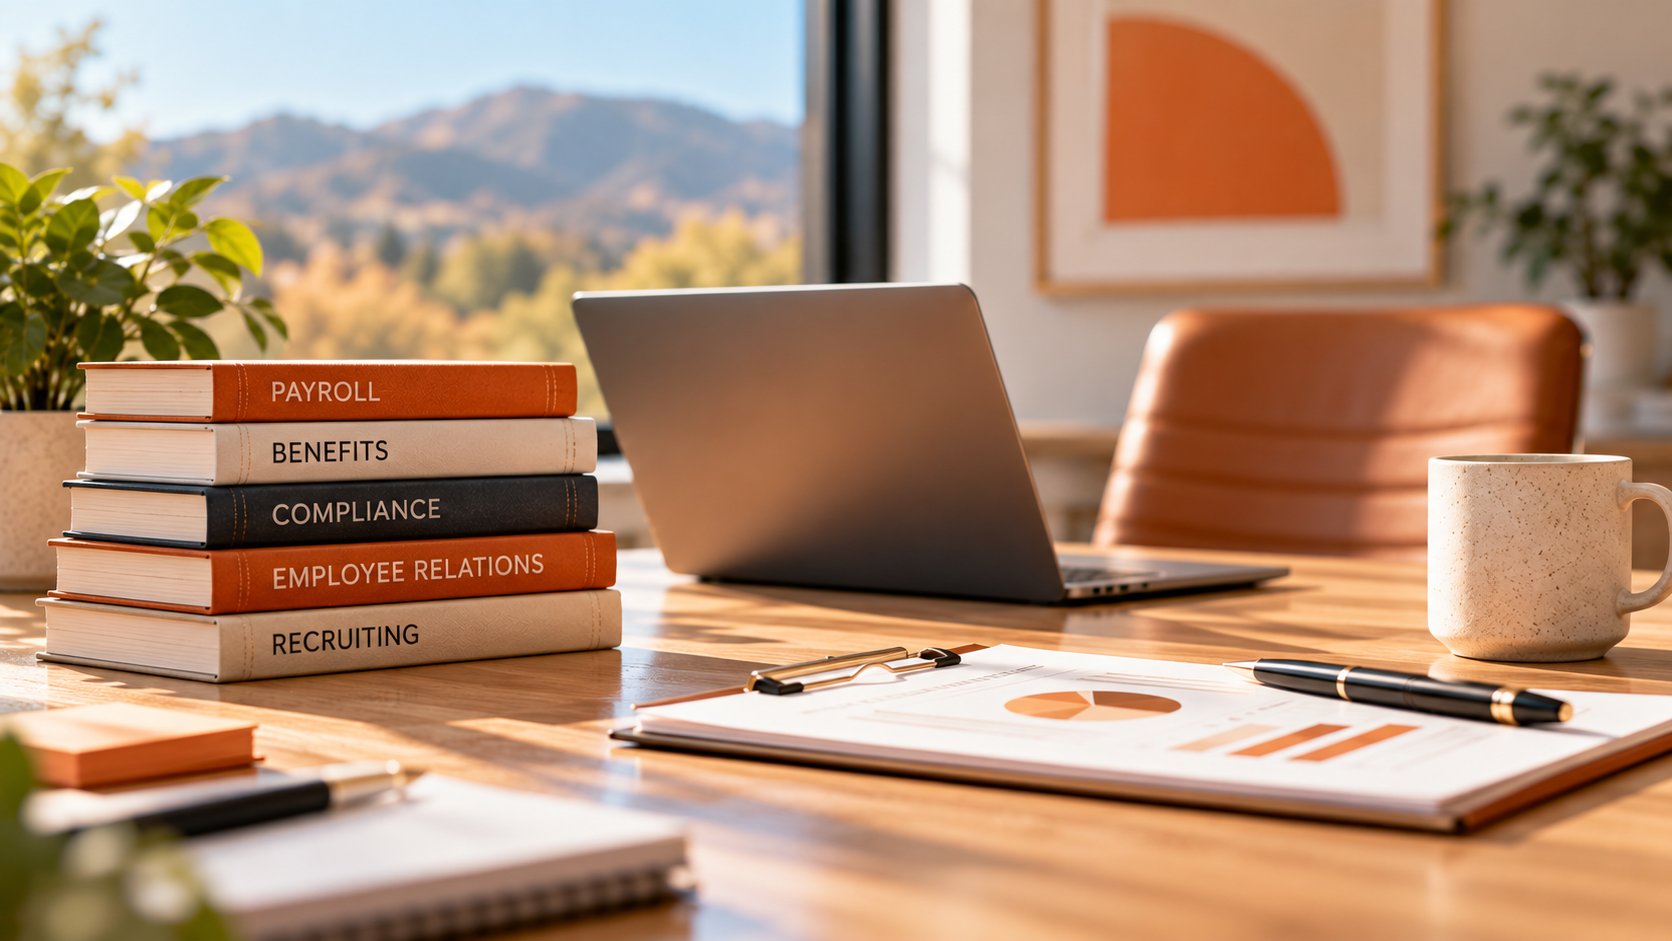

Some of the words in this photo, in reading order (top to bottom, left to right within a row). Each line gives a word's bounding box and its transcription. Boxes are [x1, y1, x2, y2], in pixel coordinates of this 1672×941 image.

[271, 380, 381, 403] PAYROLL
[272, 439, 389, 464] BENEFITS
[272, 498, 441, 526] COMPLIANCE
[273, 560, 405, 590] EMPLOYEE
[414, 553, 544, 581] RELATIONS
[272, 623, 419, 656] RECRUITING
